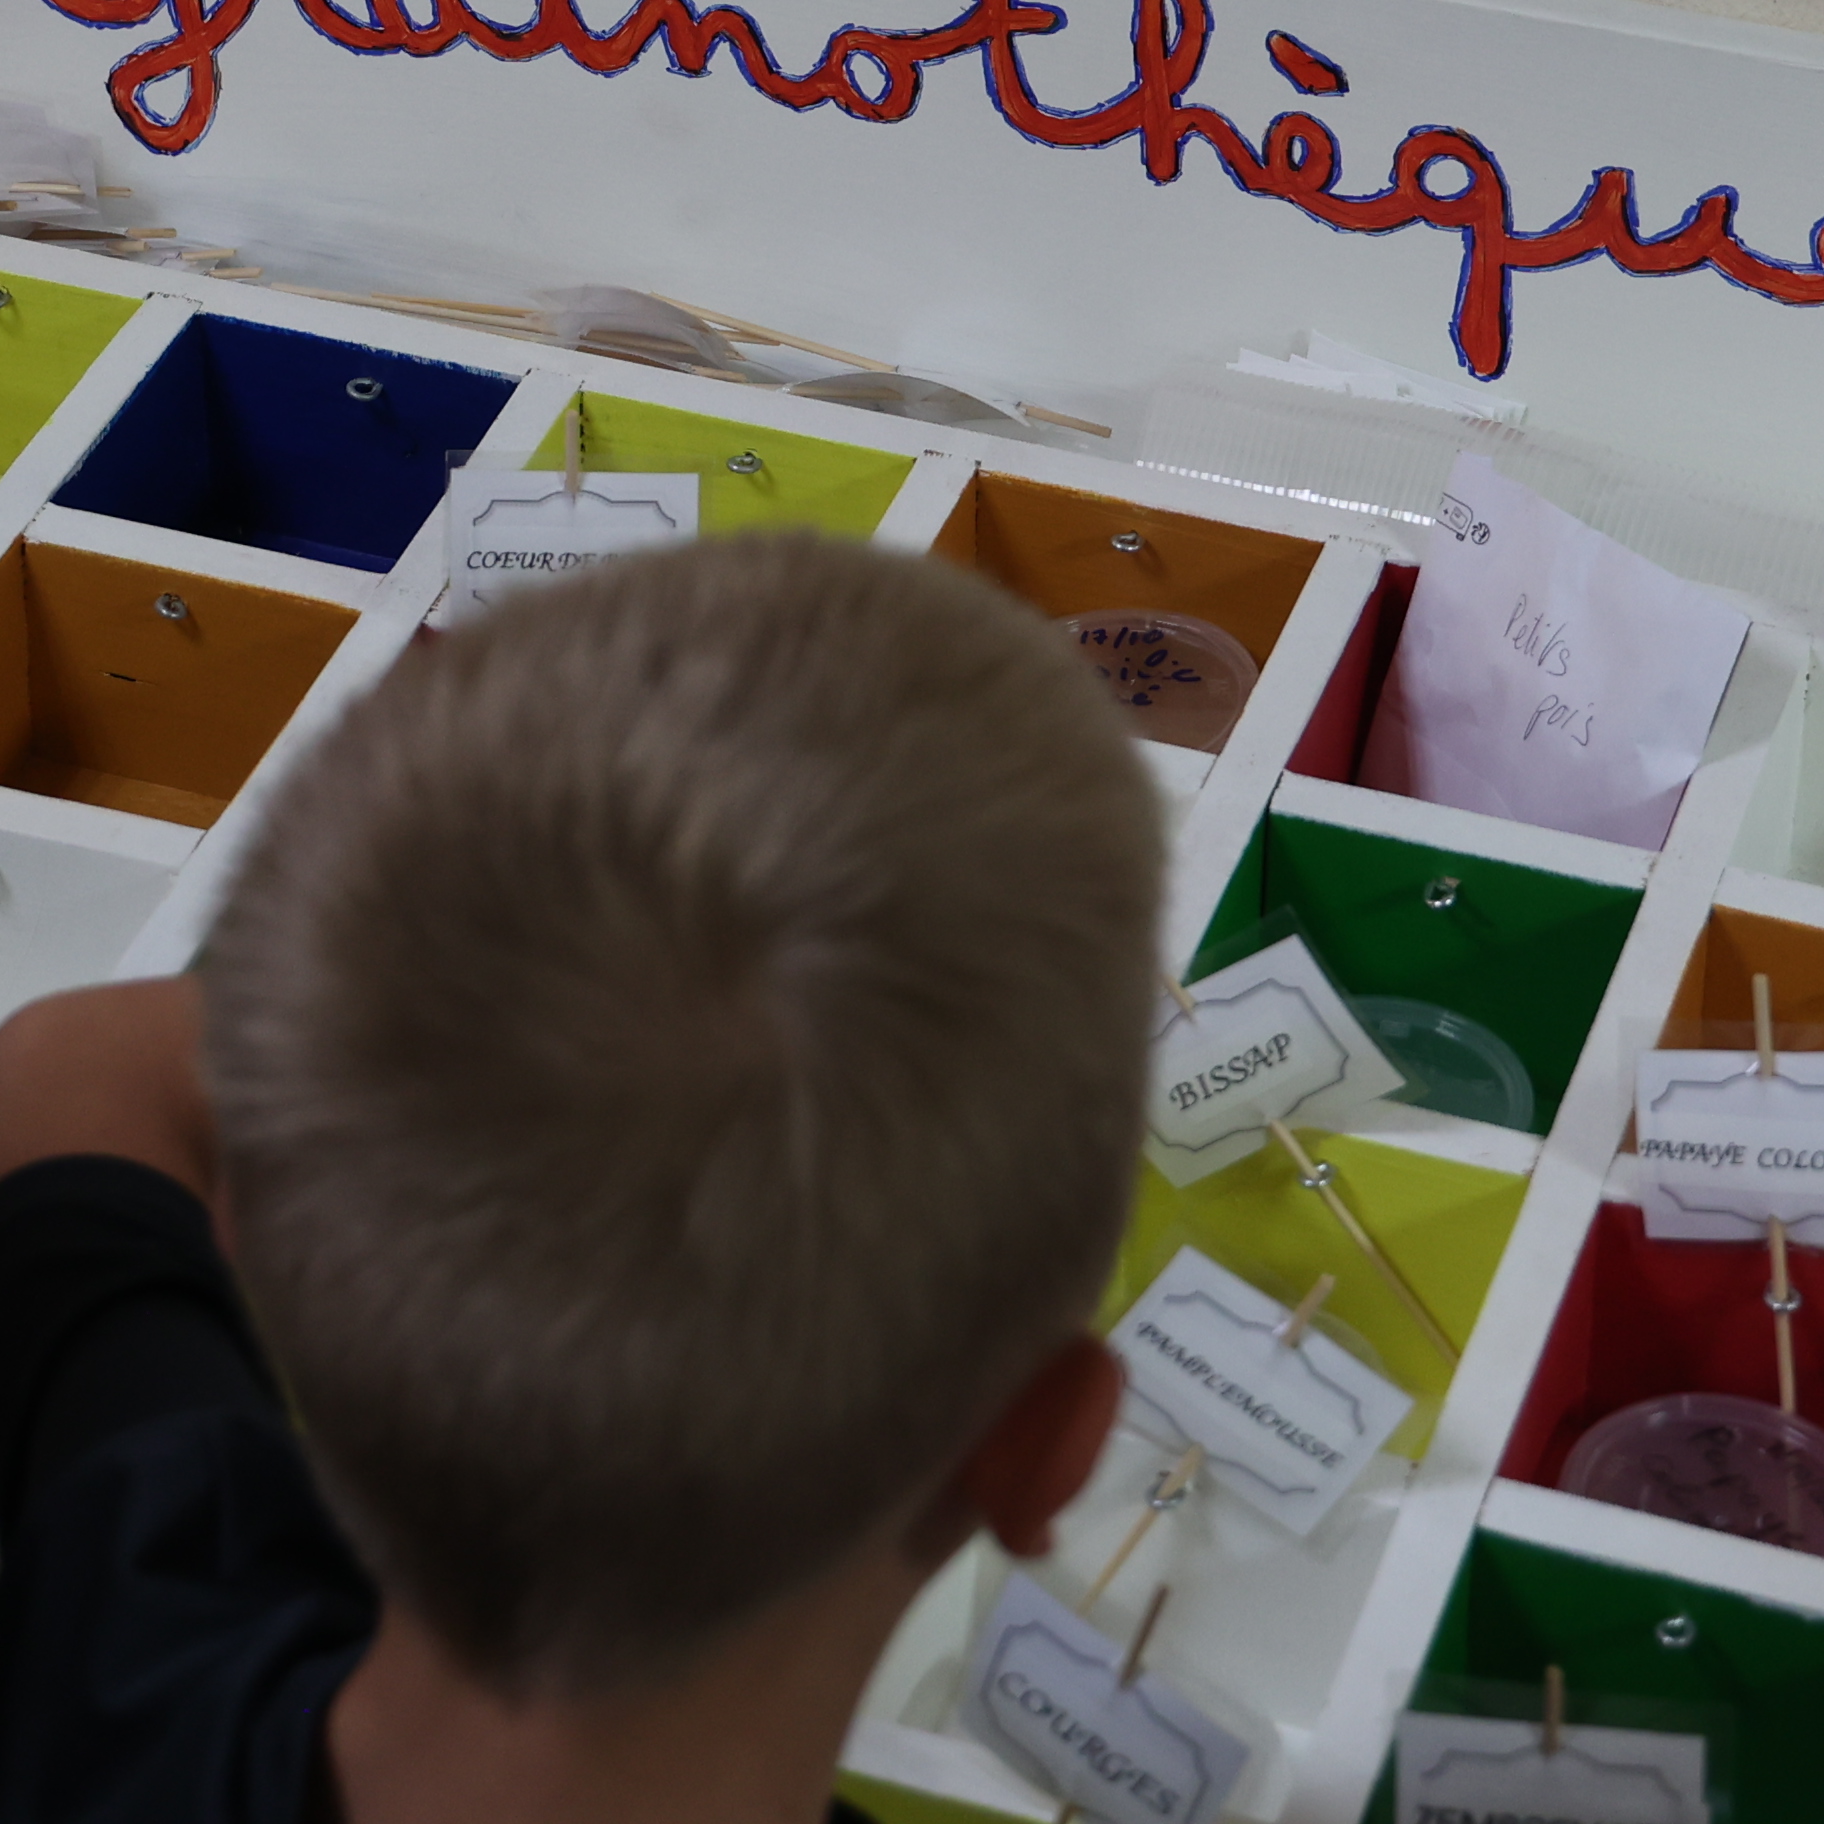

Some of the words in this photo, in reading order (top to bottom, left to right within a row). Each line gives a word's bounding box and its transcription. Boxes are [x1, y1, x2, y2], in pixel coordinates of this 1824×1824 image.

[466, 551, 556, 572] COEUR
[1169, 1032, 1292, 1111] BISSAP
[1640, 1138, 1747, 1168] PAPAYE
[1136, 1320, 1344, 1470] PAMPLEMOUSSE
[996, 1670, 1181, 1817] COURGES
